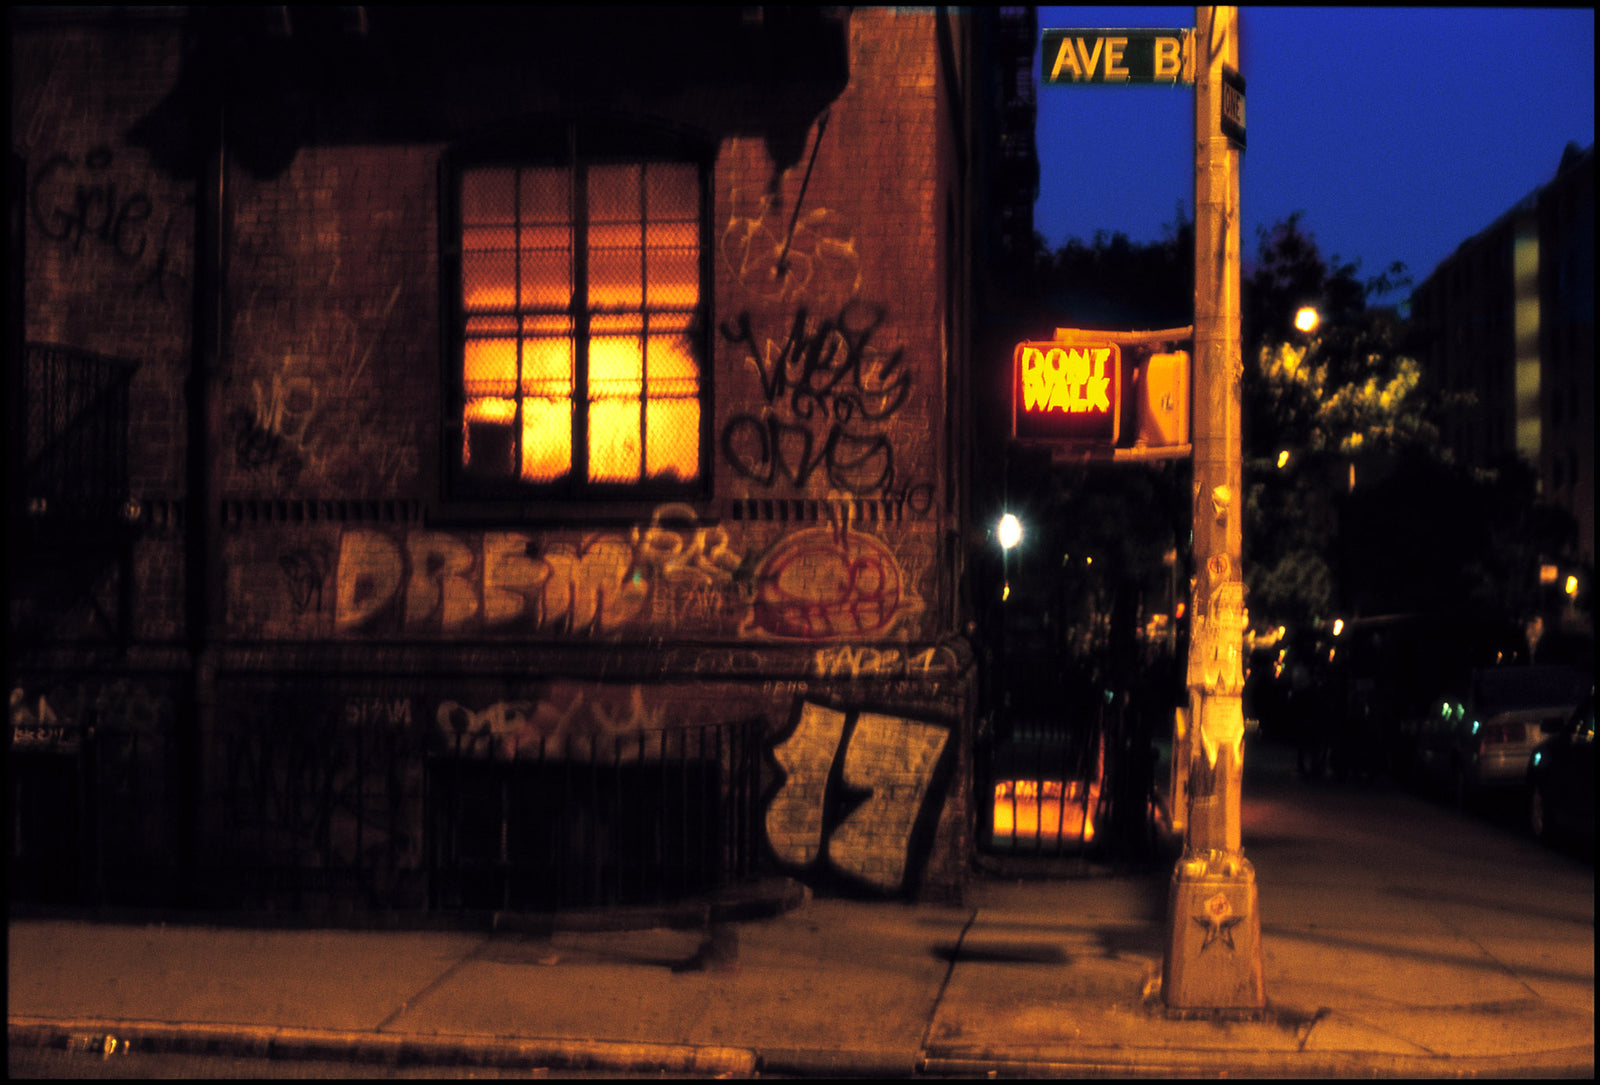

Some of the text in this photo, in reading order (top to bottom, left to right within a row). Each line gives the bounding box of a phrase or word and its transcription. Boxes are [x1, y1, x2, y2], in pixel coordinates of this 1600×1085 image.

[1049, 36, 1181, 83] AVE B
[1224, 83, 1241, 121] ONE
[1023, 377, 1110, 413] WALK
